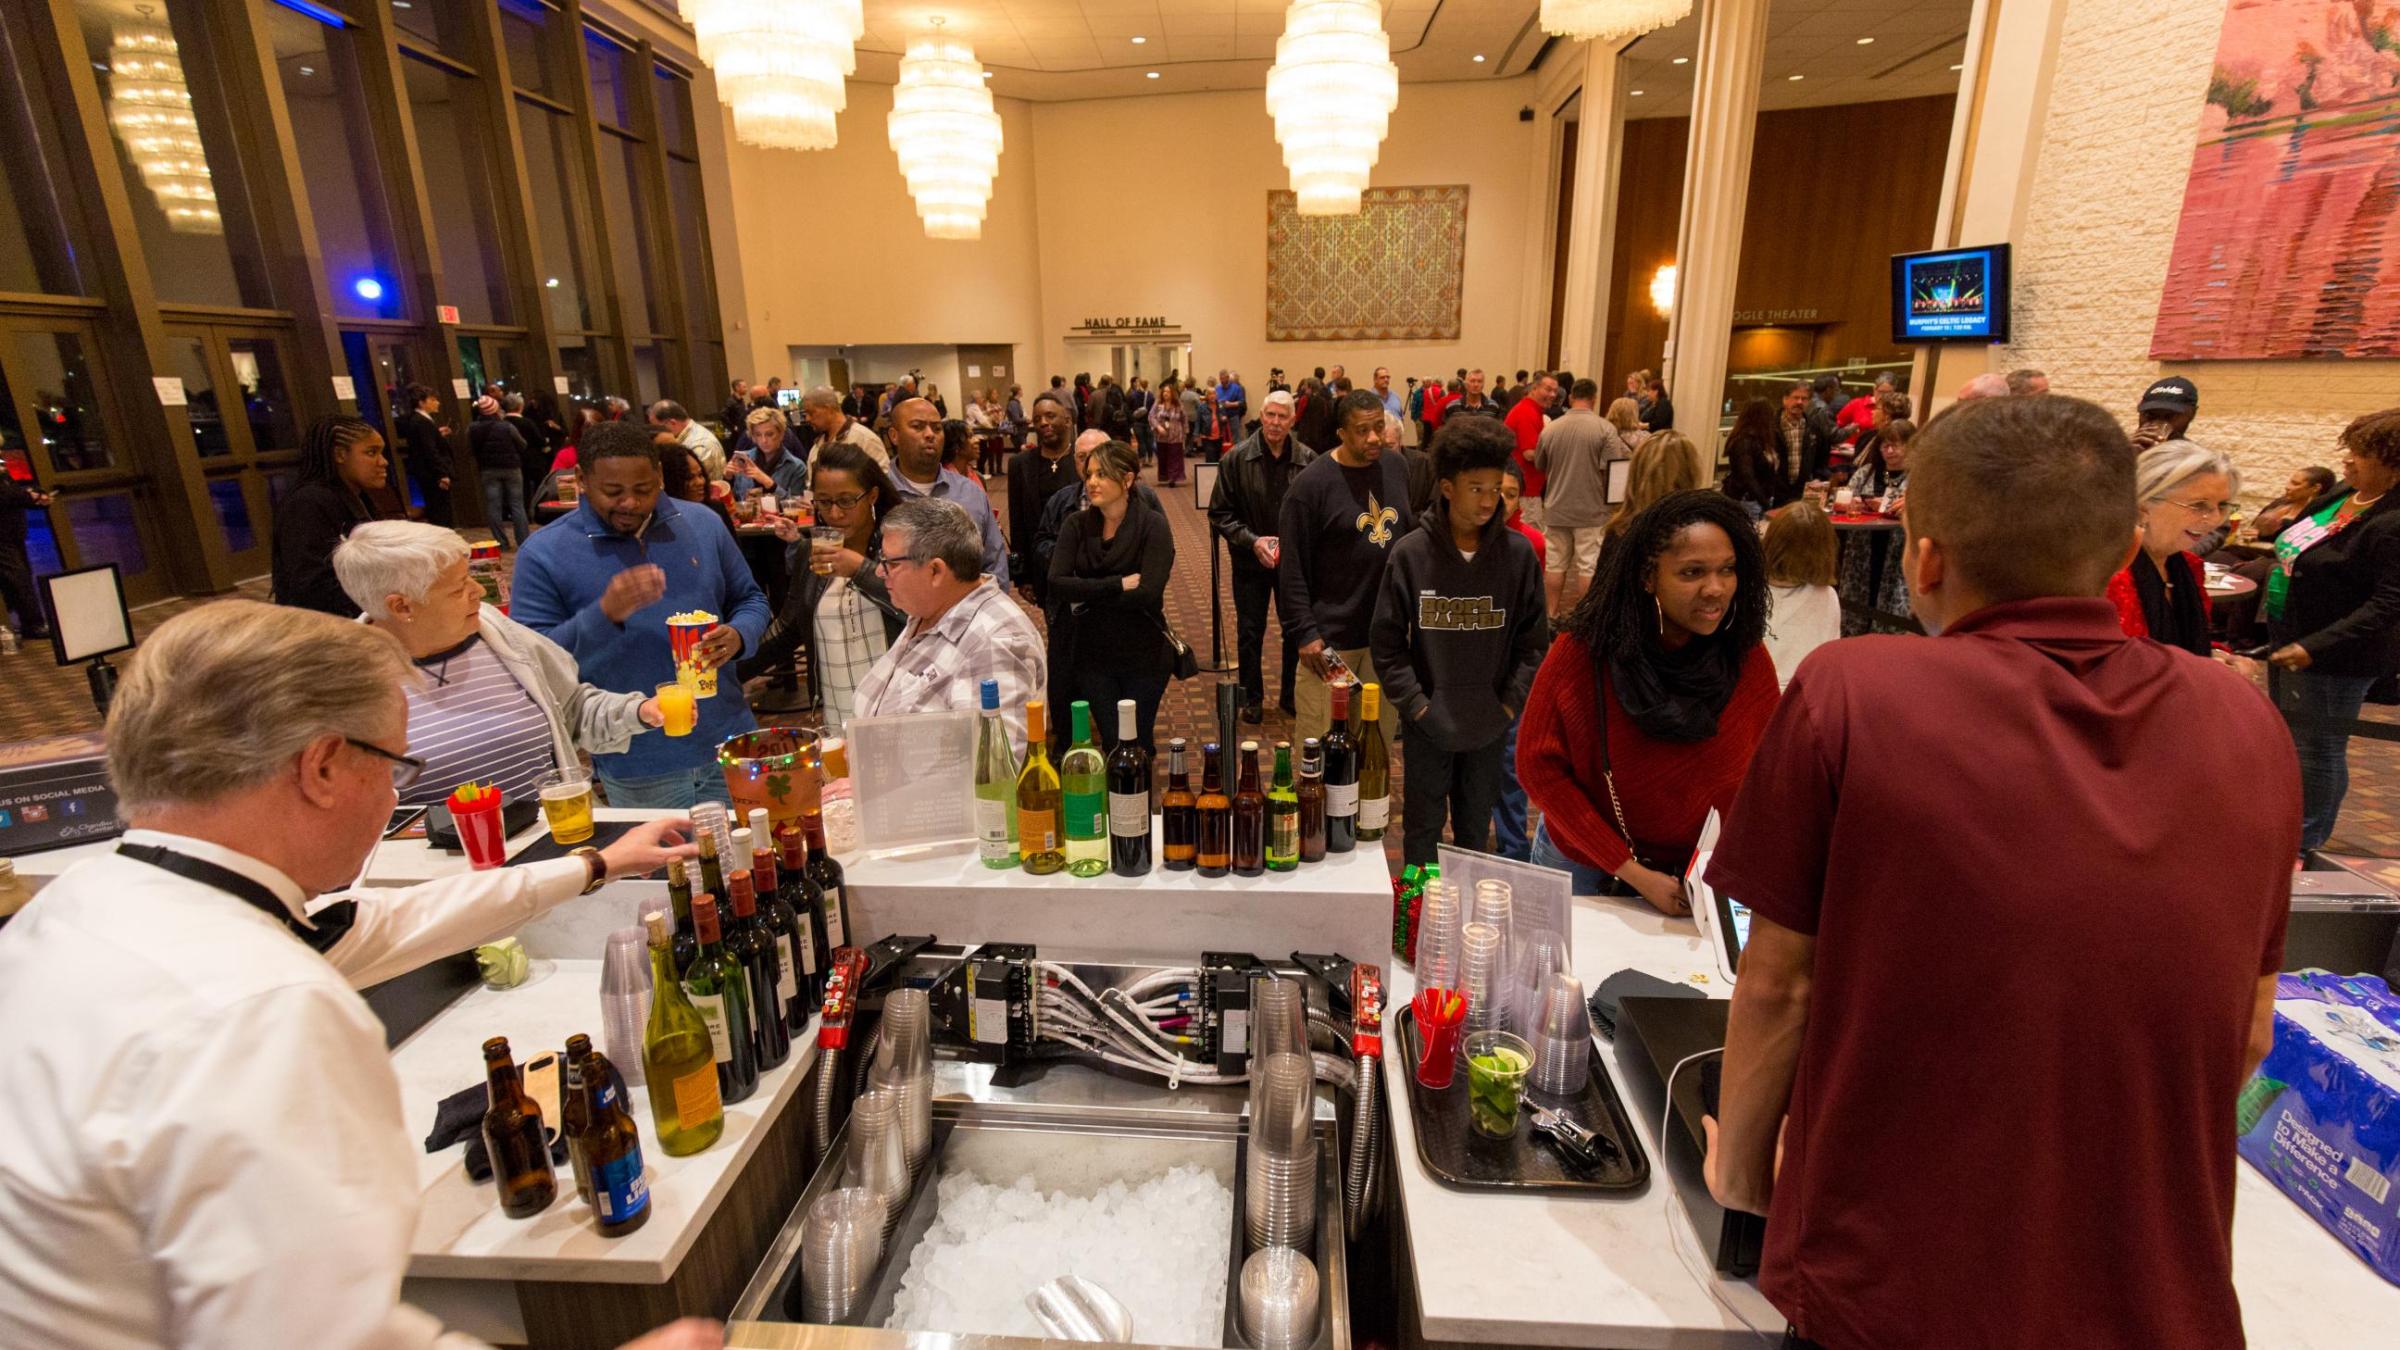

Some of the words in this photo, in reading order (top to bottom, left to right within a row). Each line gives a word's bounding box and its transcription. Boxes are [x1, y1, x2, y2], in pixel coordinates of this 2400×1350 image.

[1084, 318, 1112, 329] HALL
[1115, 317, 1131, 328] OF
[1135, 316, 1166, 328] FAME
[1767, 308, 1818, 320] THEATER
[1420, 597, 1491, 613] HOOPS
[1420, 612, 1505, 629] HAPPEN
[14, 796, 31, 804] ON
[32, 790, 71, 802] SOCIAL
[72, 784, 106, 795] MEDIA
[2281, 1109, 2344, 1163] Designed
[2276, 1120, 2291, 1136] to
[2291, 1132, 2327, 1167] Make
[2327, 1163, 2339, 1176] a
[2273, 1130, 2338, 1190] Difference
